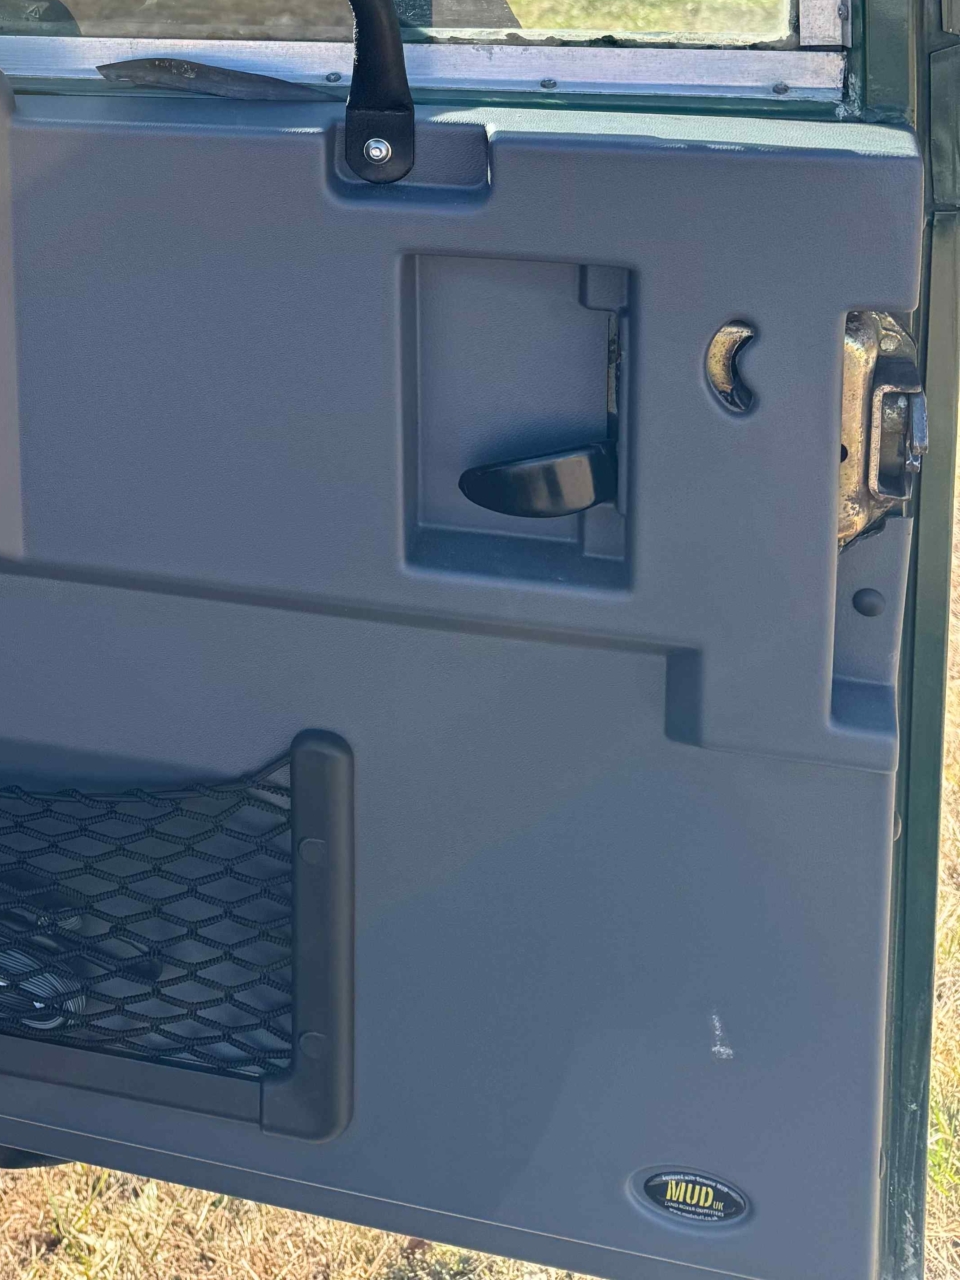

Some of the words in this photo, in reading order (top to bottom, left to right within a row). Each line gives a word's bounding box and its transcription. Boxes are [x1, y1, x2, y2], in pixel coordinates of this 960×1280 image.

[717, 1183, 728, 1192] MUD
[666, 1180, 714, 1207] MUD
[713, 1201, 724, 1211] UK
[696, 1207, 724, 1217] OUTFITTERS
